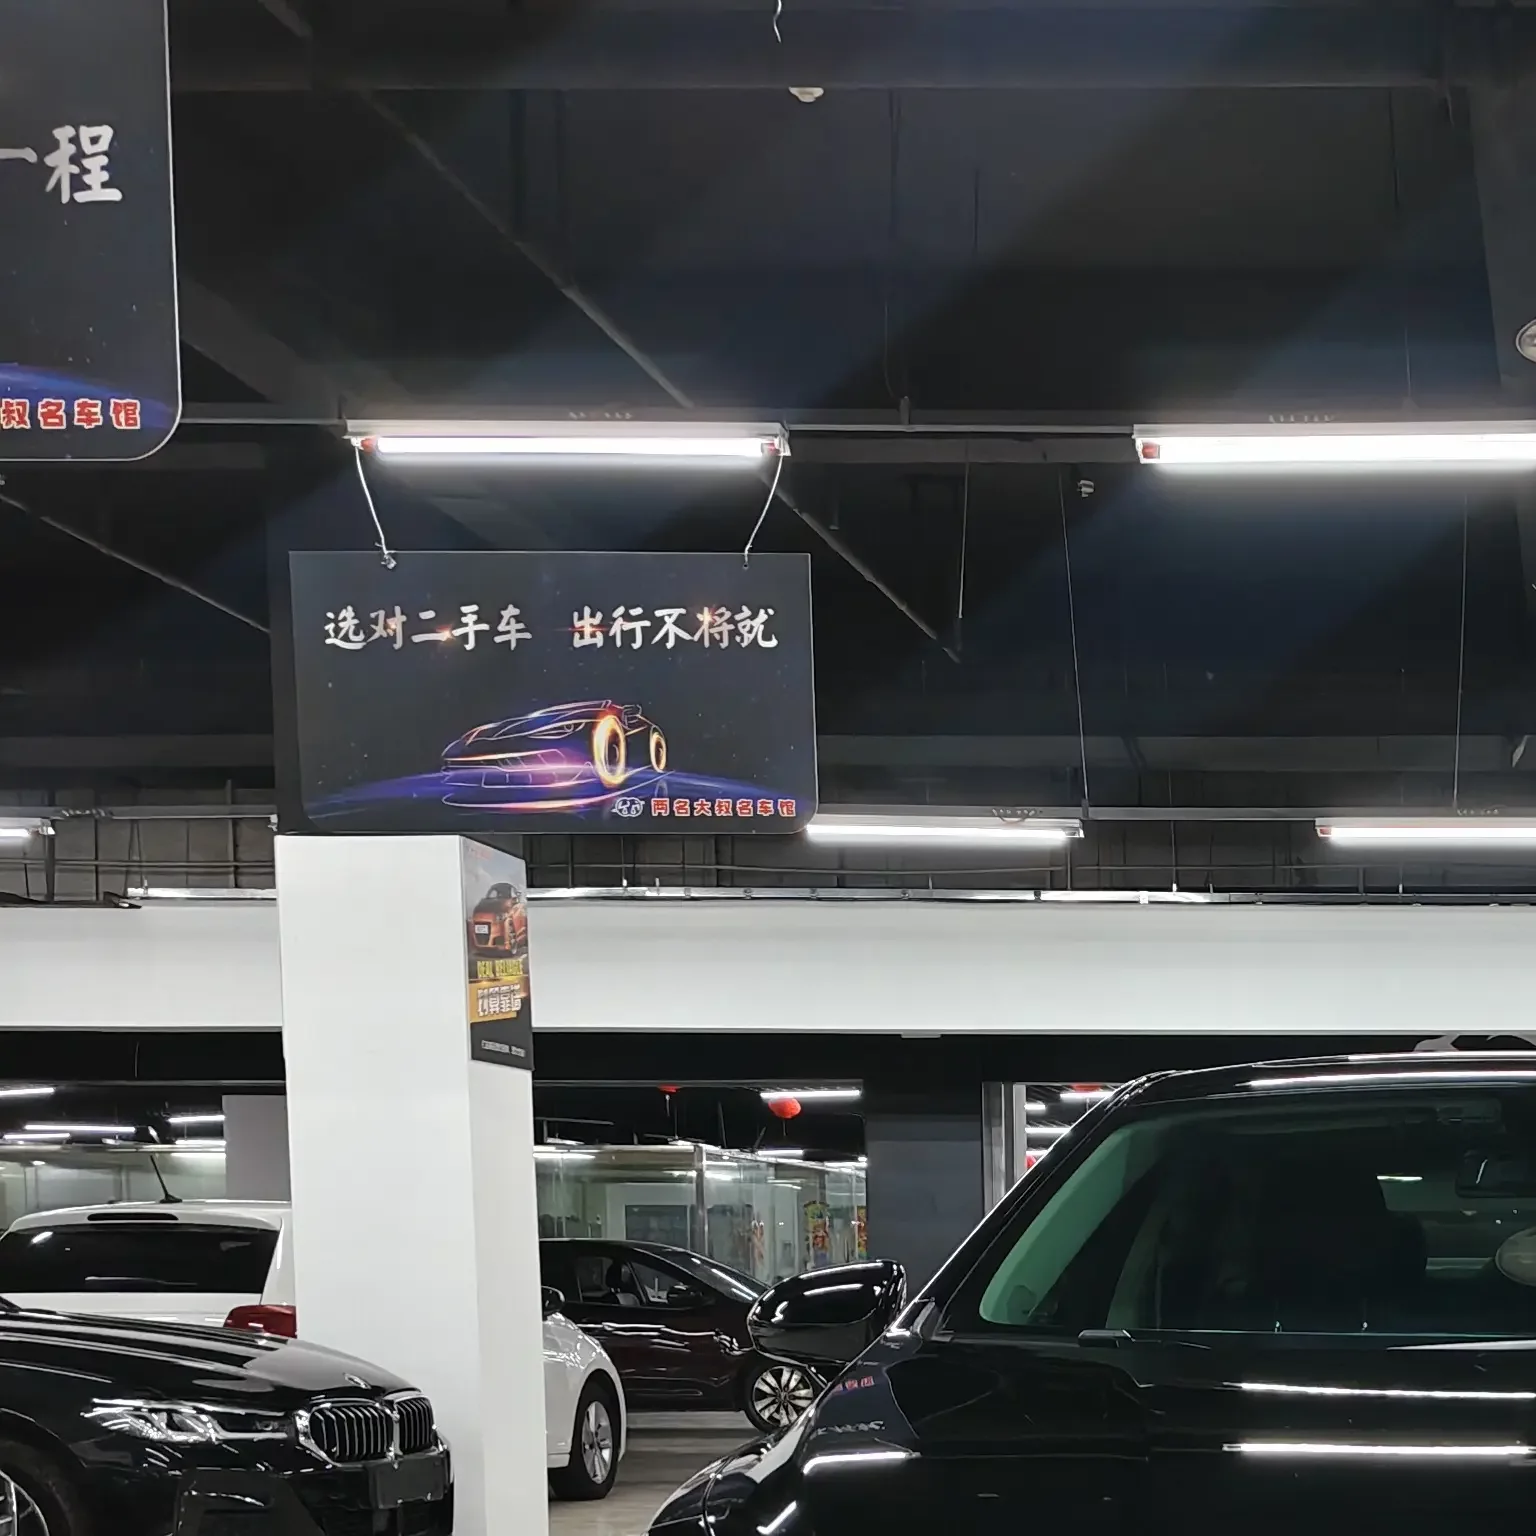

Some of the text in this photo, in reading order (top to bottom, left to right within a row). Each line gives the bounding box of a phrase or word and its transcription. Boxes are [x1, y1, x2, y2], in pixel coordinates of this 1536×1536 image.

[0, 399, 141, 430] 叔名车馆
[324, 604, 778, 651] 选对二手车 出行不将就
[650, 798, 797, 817] 两名大叔名车馆
